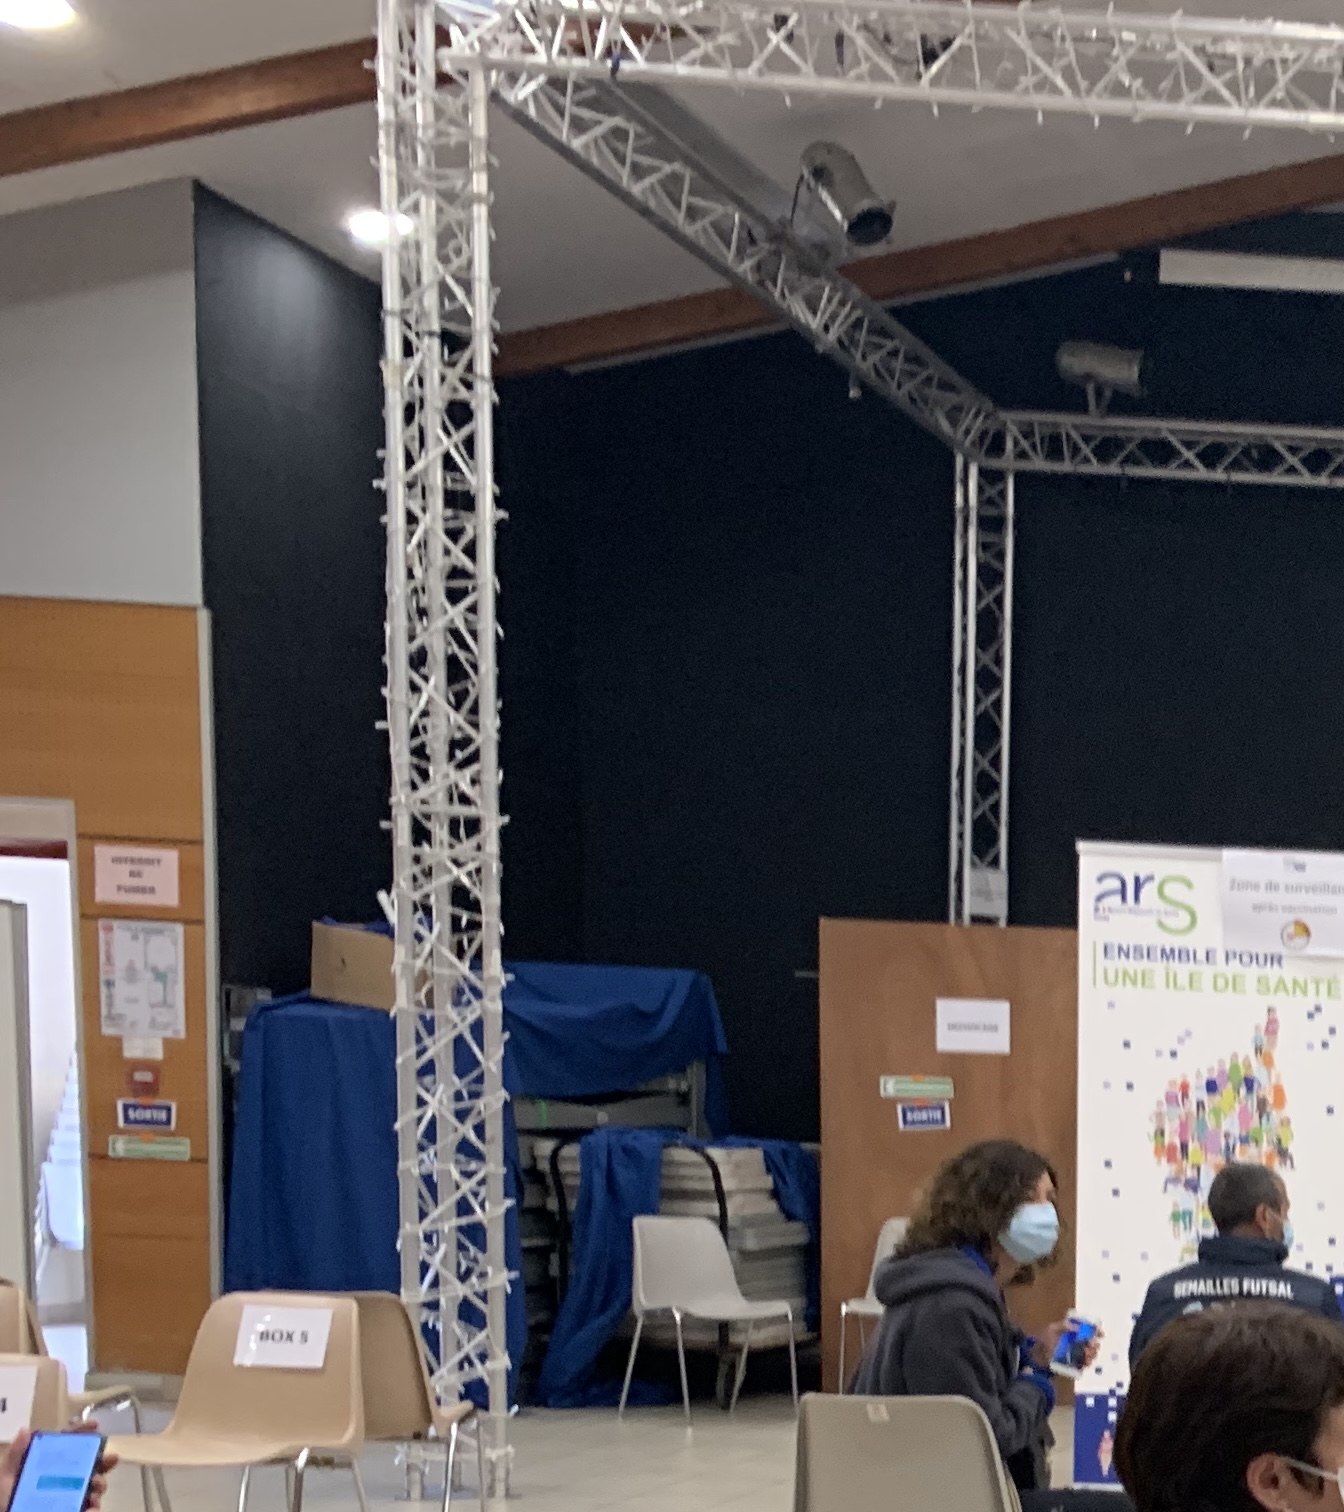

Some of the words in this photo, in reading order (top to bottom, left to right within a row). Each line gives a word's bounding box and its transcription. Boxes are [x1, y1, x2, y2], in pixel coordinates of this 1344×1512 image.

[1229, 879, 1261, 892] Zone
[1265, 881, 1280, 894] de
[1103, 942, 1217, 966] ENSEMBLE
[1225, 949, 1284, 969] POUR
[1103, 967, 1156, 989] UNE
[1213, 973, 1247, 995] DE
[1256, 974, 1342, 1000] SANTÉ
[1242, 1276, 1294, 1300] FUTSAL
[260, 1328, 295, 1344] BOX
